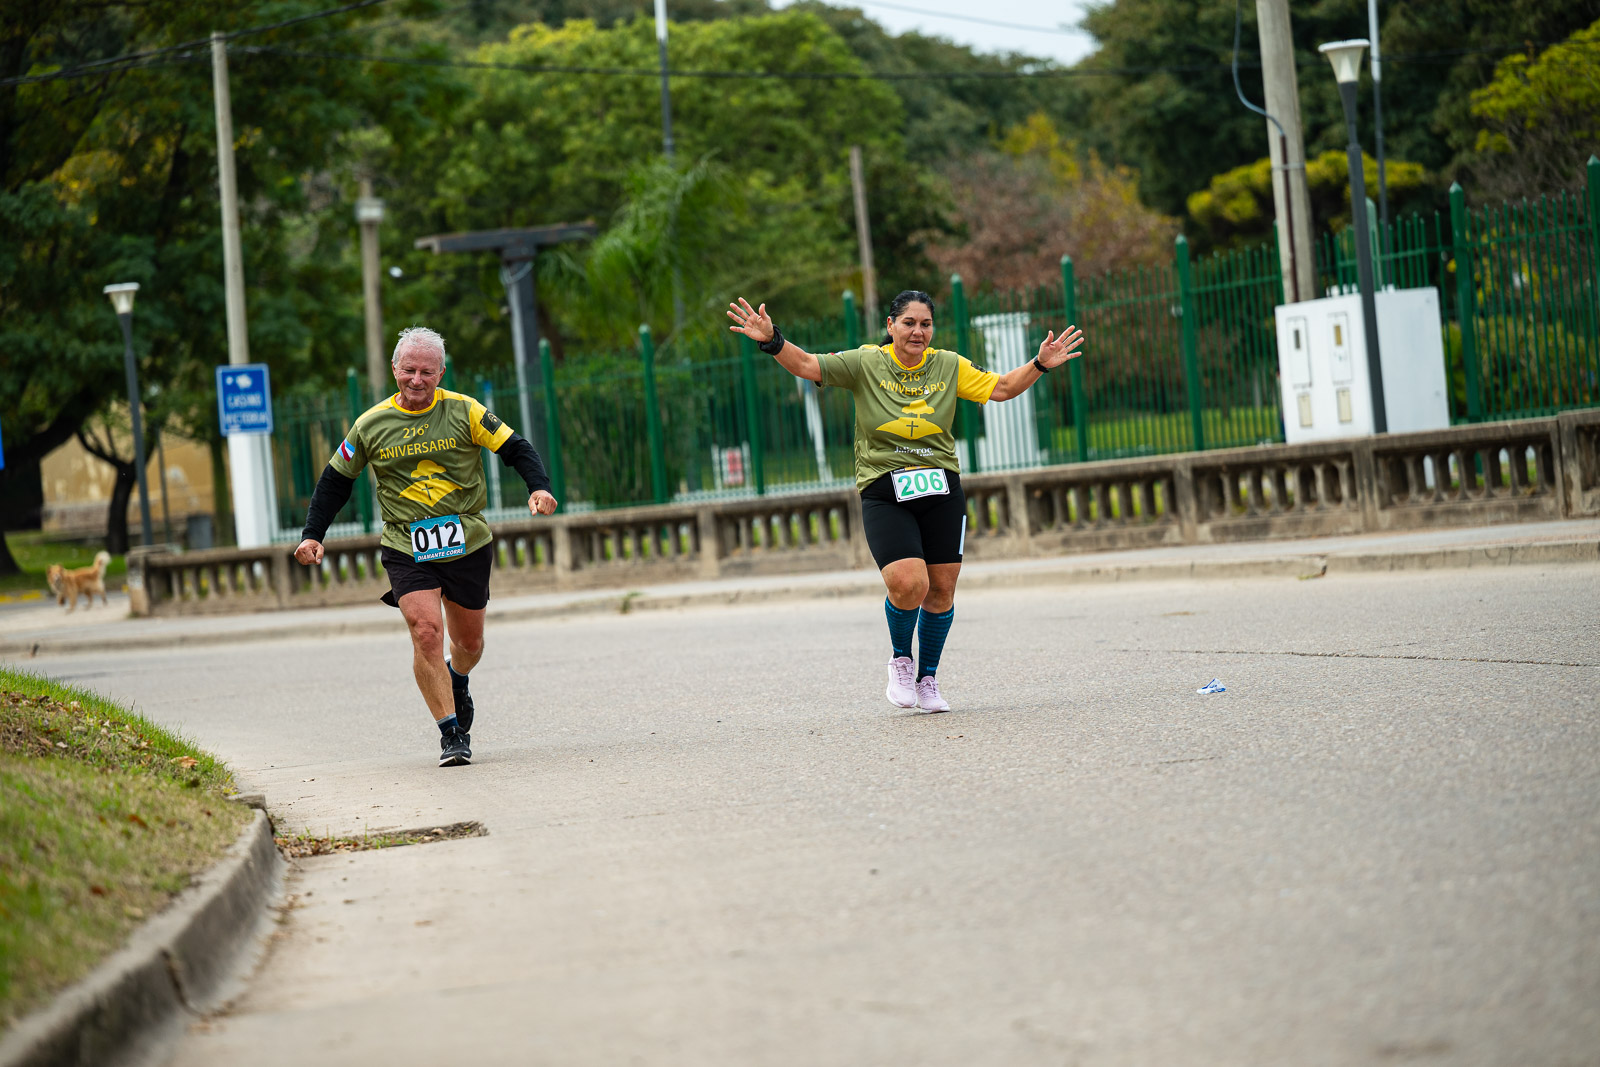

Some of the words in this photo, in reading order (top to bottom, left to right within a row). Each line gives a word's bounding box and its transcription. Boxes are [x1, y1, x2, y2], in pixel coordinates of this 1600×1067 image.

[879, 379, 946, 396] ANIVERSARIO
[379, 437, 457, 460] ANIVERSARIO
[897, 471, 944, 497] 206
[414, 521, 461, 553] 012
[417, 551, 446, 561] DIAMANTE
[446, 547, 464, 556] CORRE
